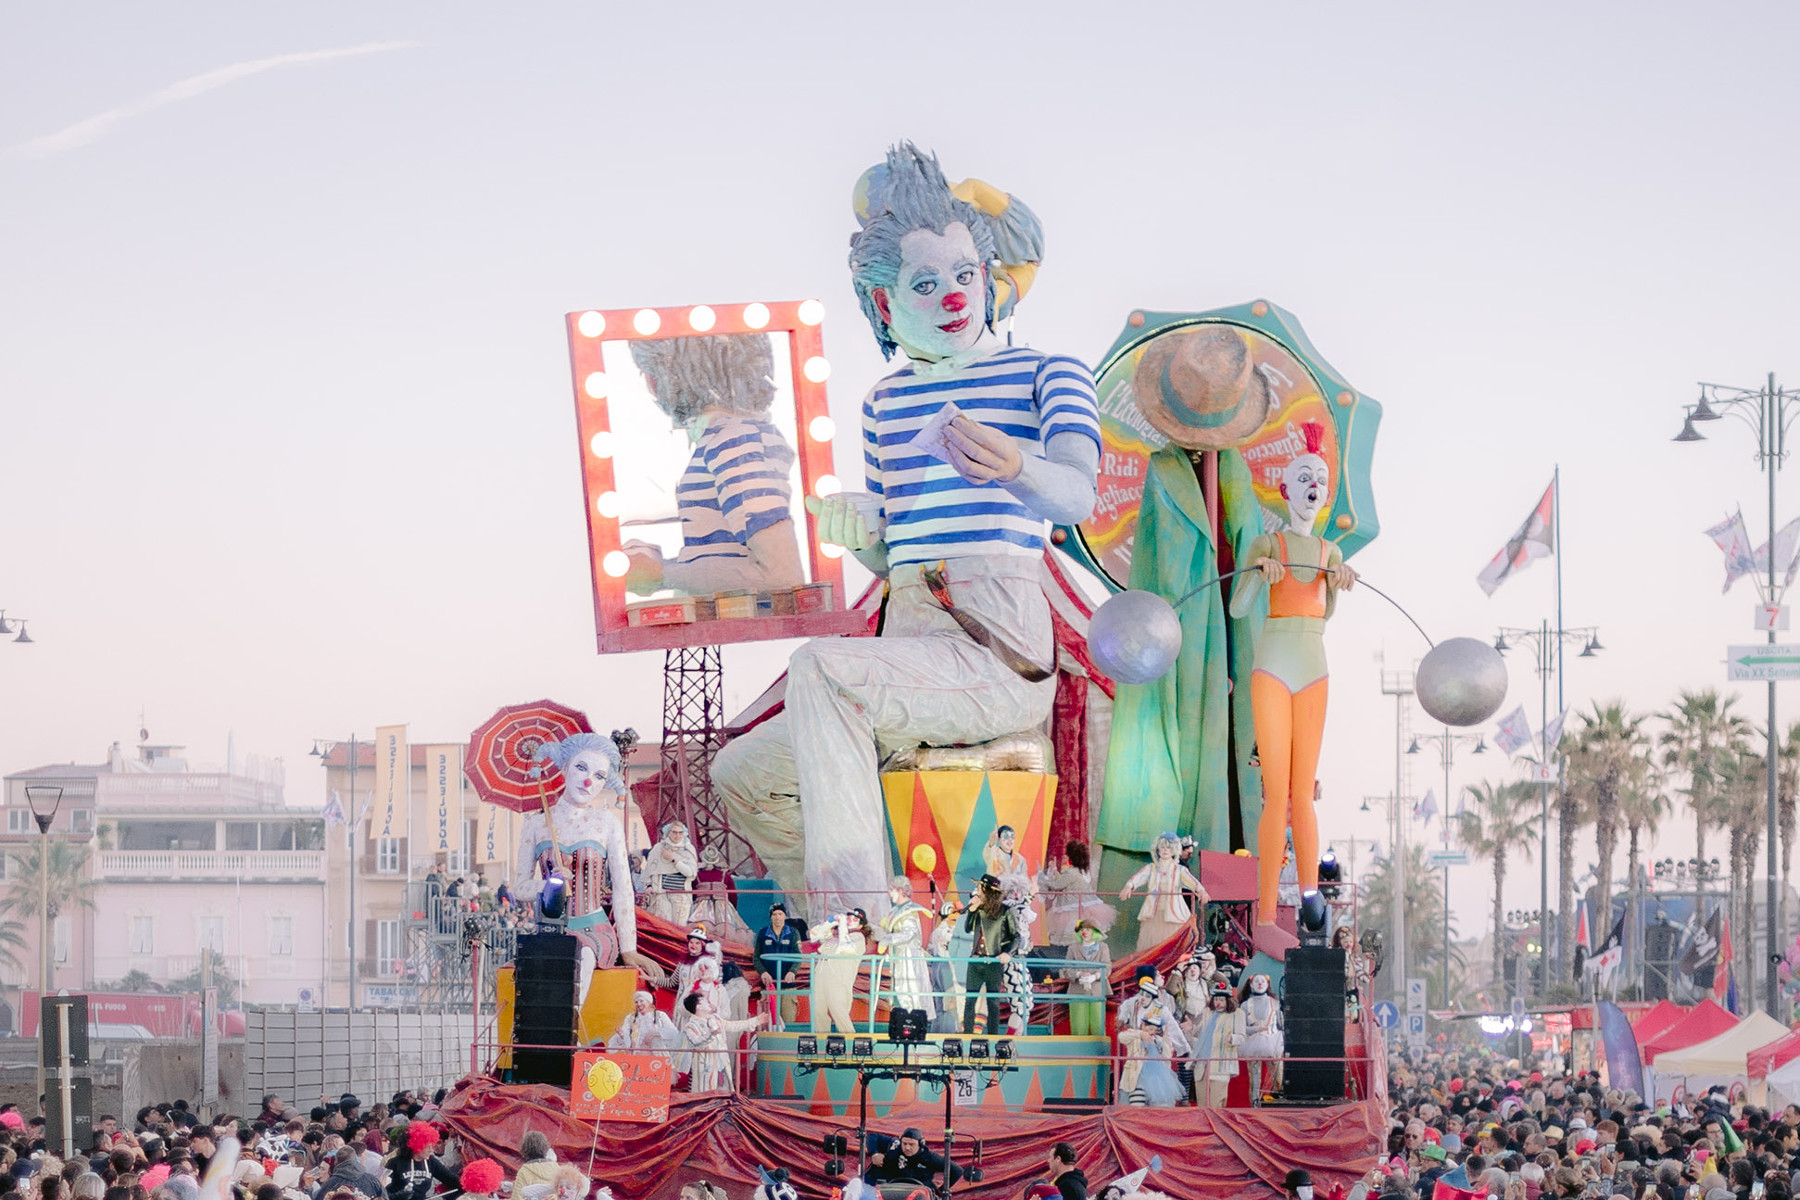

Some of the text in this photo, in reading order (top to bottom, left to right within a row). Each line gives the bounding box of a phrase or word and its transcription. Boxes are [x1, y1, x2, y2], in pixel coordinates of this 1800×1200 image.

[1104, 452, 1138, 477] Ridi
[1090, 481, 1144, 524] agliacci
[1766, 607, 1778, 626] 7
[1541, 768, 1550, 779] 6
[959, 1080, 972, 1096] 25
